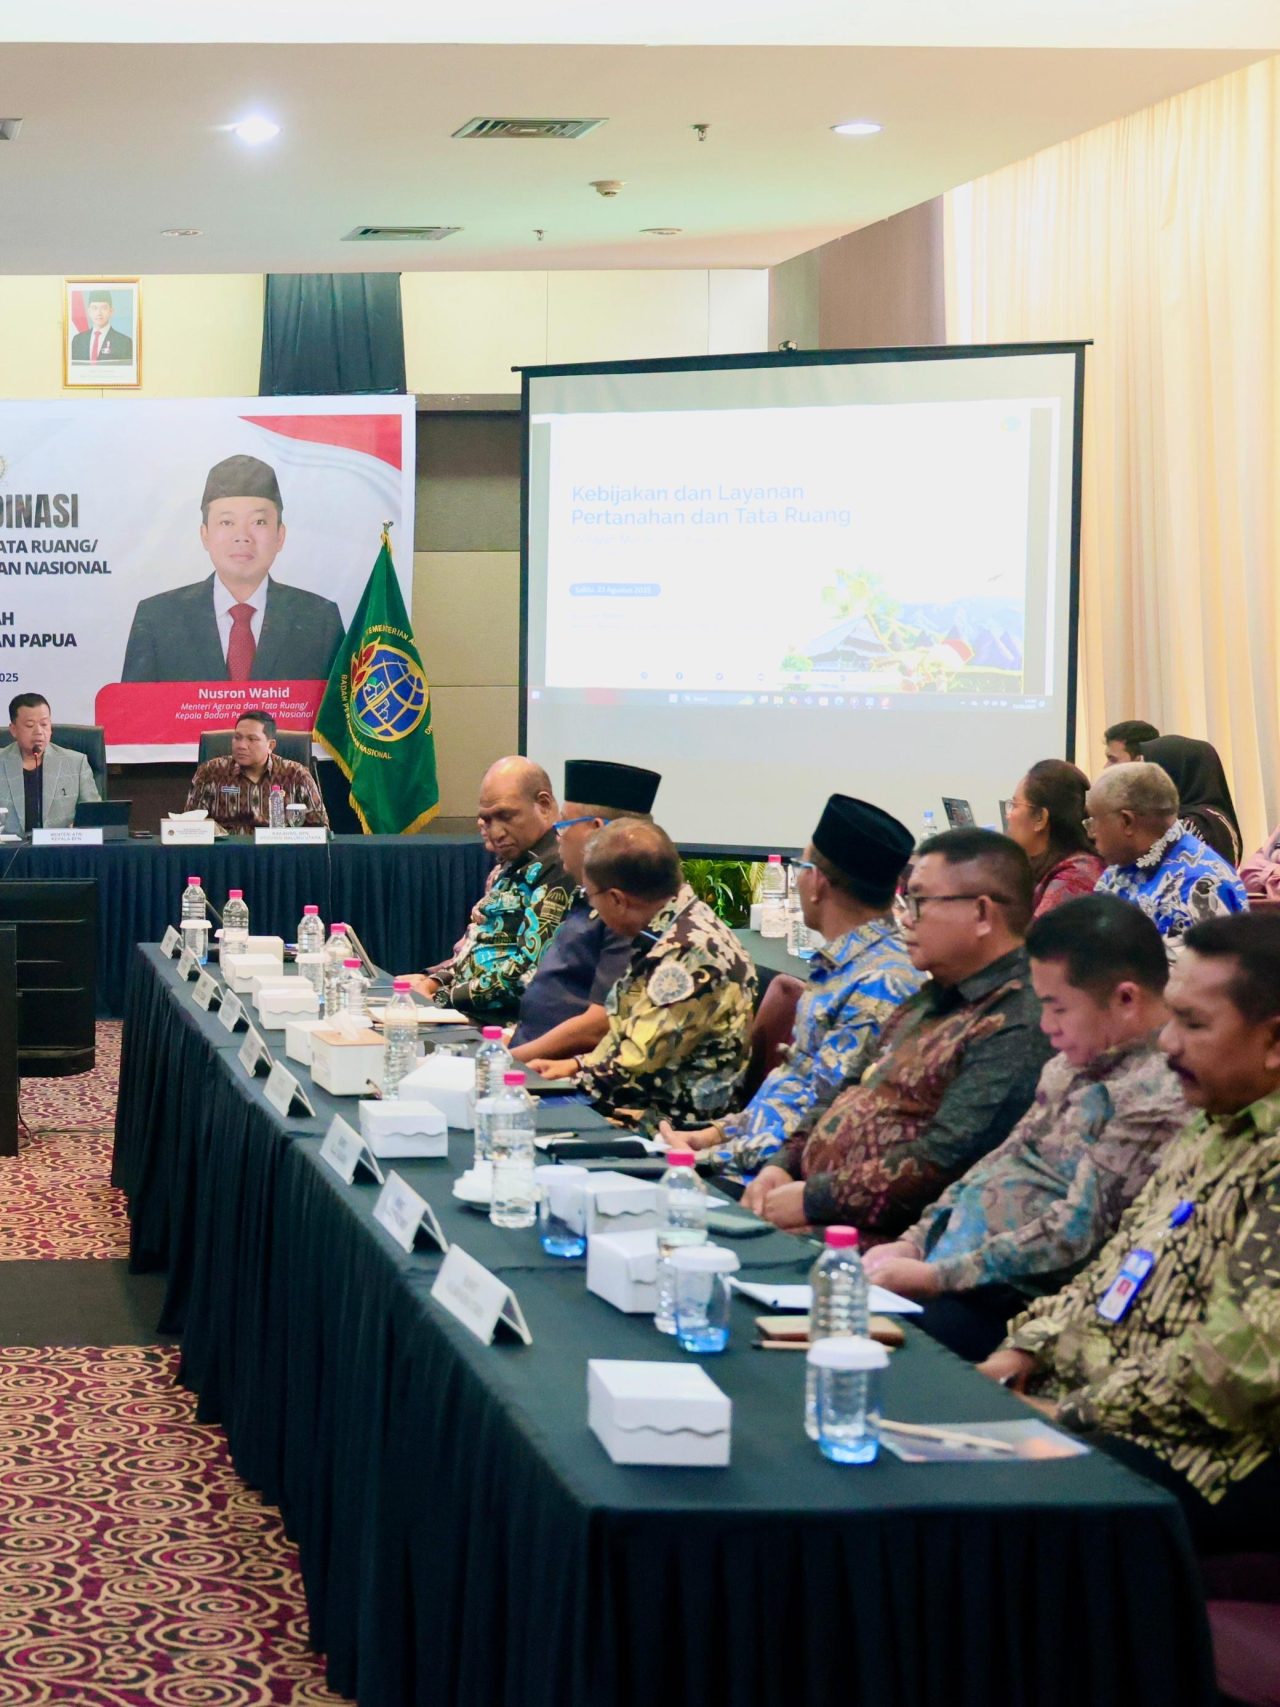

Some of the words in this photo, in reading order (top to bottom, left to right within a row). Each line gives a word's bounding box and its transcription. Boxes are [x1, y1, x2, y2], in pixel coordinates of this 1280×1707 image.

[571, 485, 668, 506] Kebijakan
[674, 485, 712, 502] dan
[718, 484, 805, 505] Layanan
[571, 508, 686, 526] Pertanahan
[692, 508, 729, 525] dan
[734, 507, 777, 524] Tata
[784, 507, 851, 528] Ruang
[31, 539, 99, 554] RUANG/
[25, 560, 112, 575] NASIONAL
[19, 633, 78, 648] PAPUA
[198, 688, 246, 699] Nusron
[249, 687, 290, 699] Wahid
[181, 703, 211, 711] Menteri
[212, 703, 242, 713] Agraria
[243, 702, 259, 710] dan
[261, 702, 278, 710] Tata
[279, 701, 308, 712] Ruang/
[175, 712, 202, 721] Kepala
[203, 711, 229, 719] Badan
[278, 710, 314, 718] Nasional
